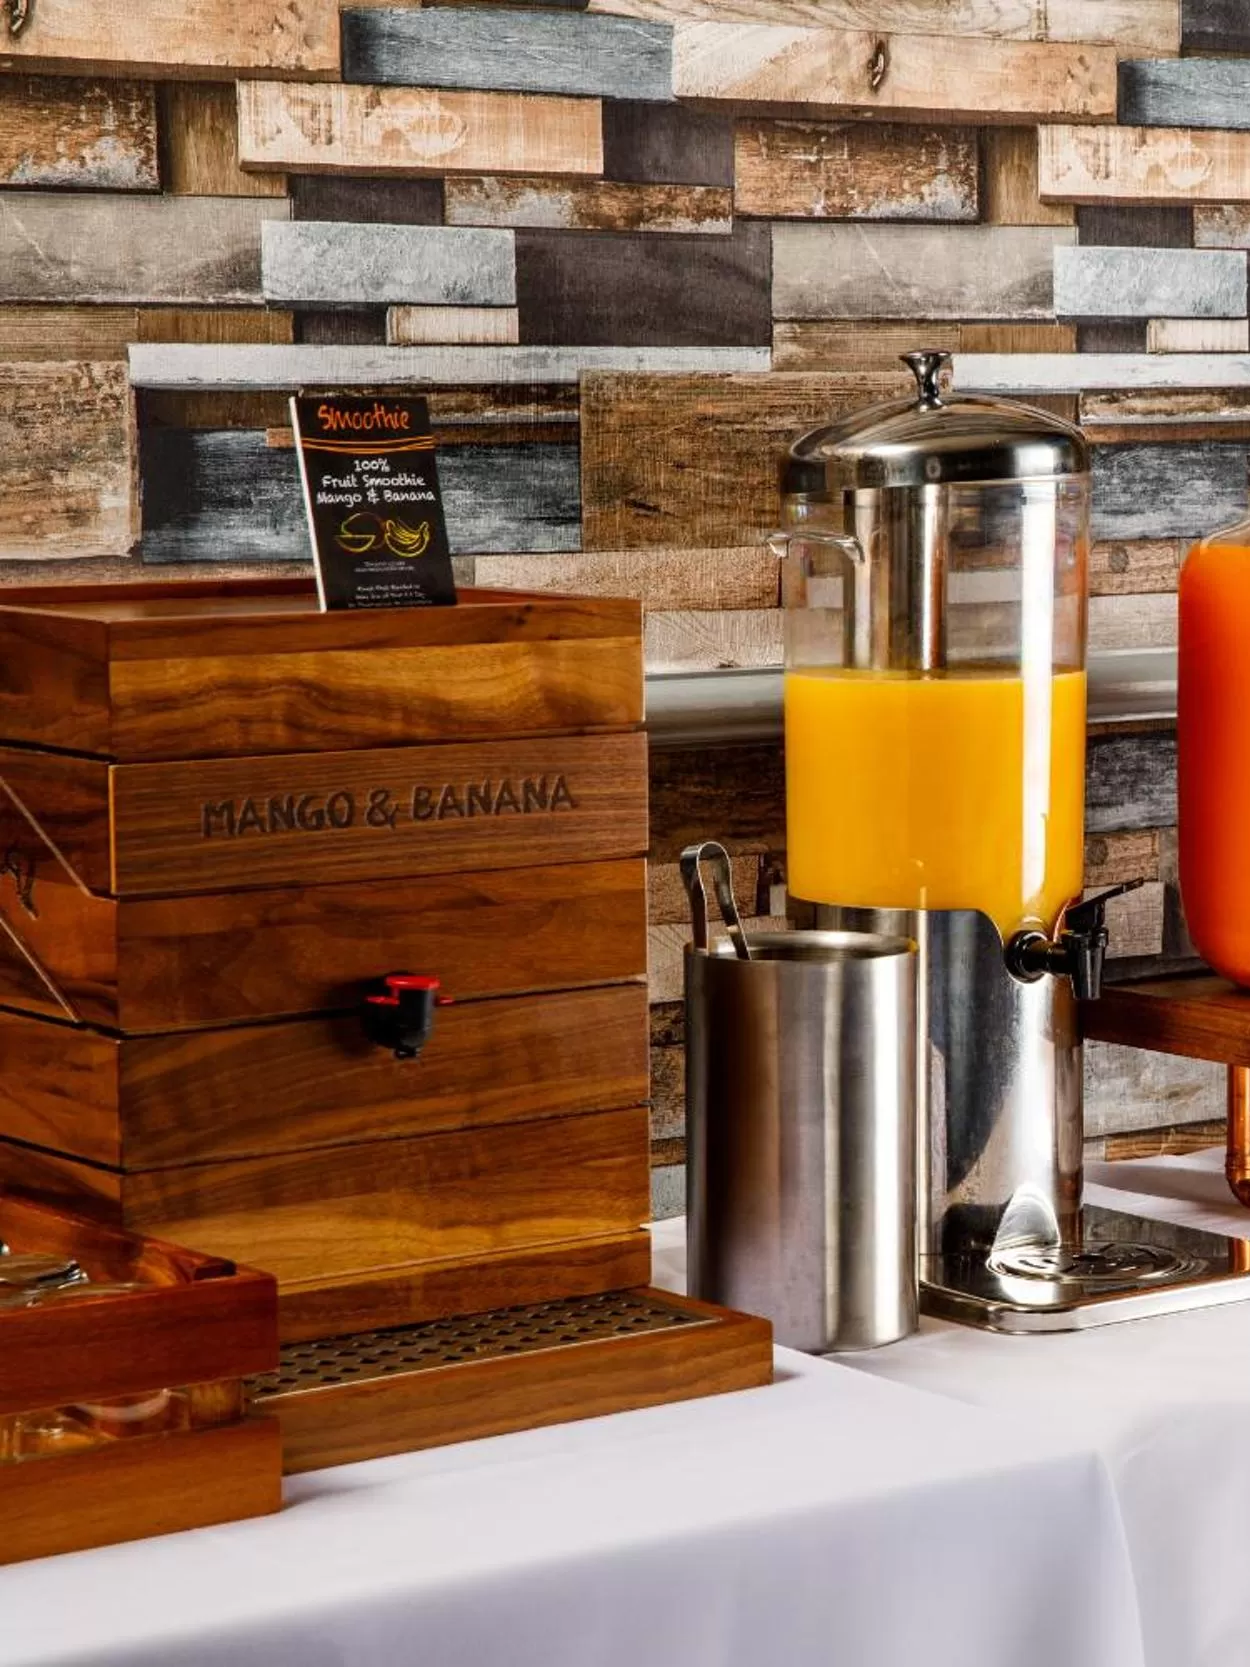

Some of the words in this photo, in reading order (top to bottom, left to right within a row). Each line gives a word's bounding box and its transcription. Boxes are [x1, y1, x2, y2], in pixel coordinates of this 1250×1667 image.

[318, 403, 410, 431] Smoothie
[354, 458, 390, 473] 100%
[322, 475, 357, 489] Fruit
[362, 471, 426, 487] Smoothie
[316, 491, 362, 508] Mango
[367, 488, 380, 505] &
[384, 489, 436, 502] Banana
[202, 790, 355, 838] MANGO
[364, 787, 400, 832] &
[411, 774, 578, 820] BANANA
